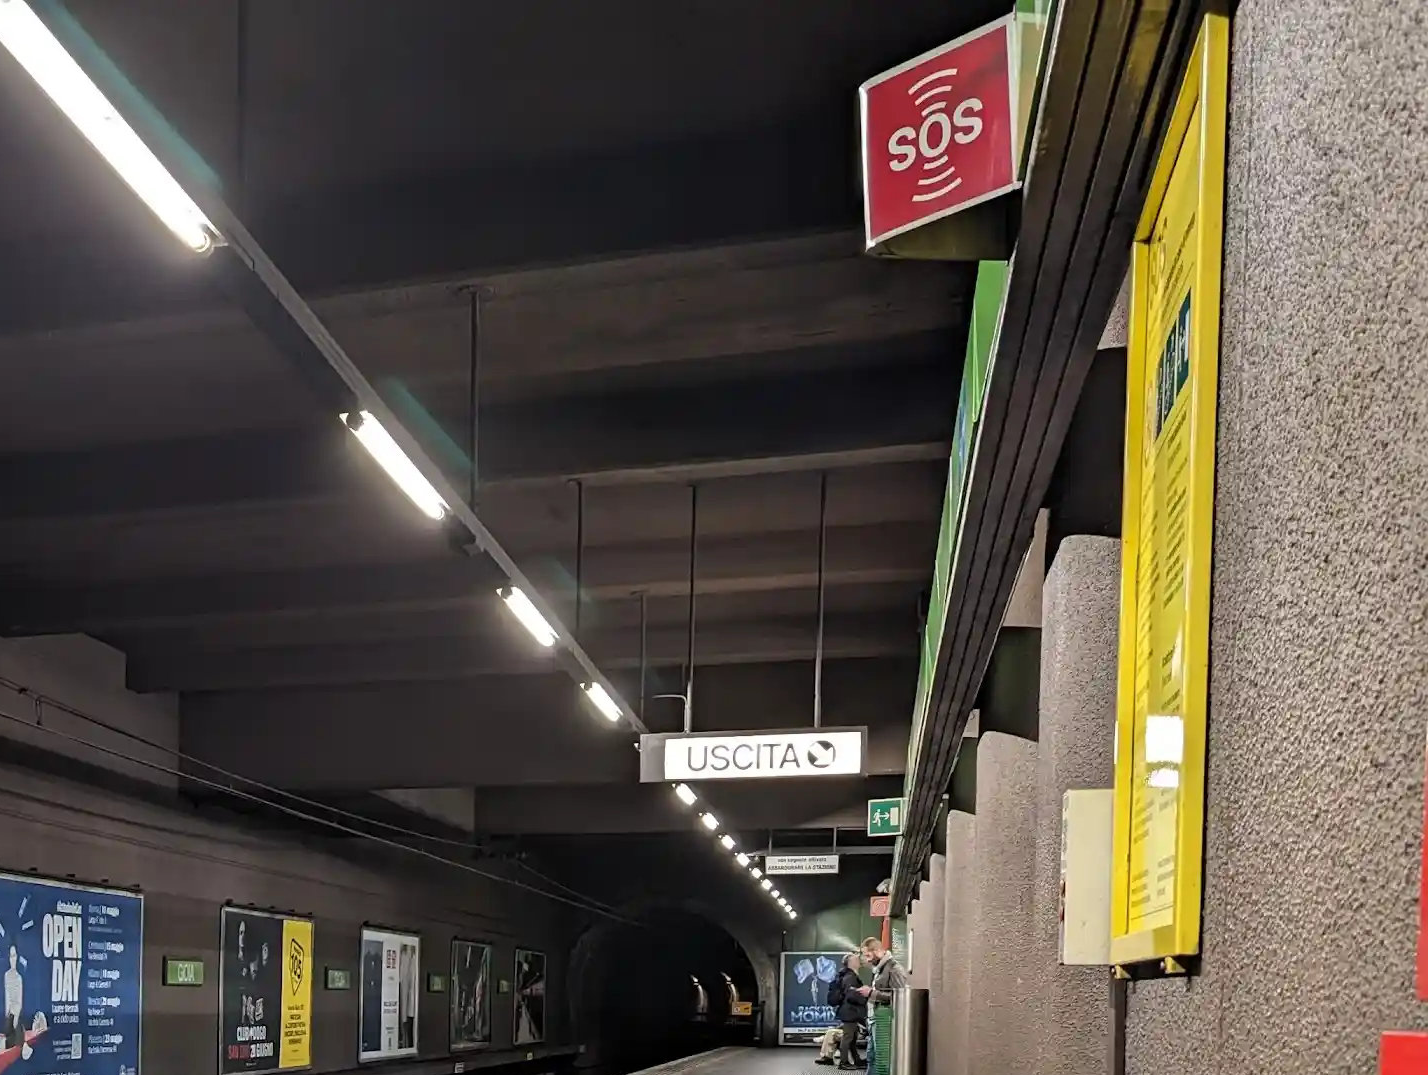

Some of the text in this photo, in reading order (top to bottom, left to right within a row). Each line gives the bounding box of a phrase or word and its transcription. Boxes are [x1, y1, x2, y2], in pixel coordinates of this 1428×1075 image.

[888, 98, 983, 171] SOS
[688, 743, 800, 771] USCITA
[43, 913, 82, 958] OPEN
[52, 960, 82, 1002] DAY
